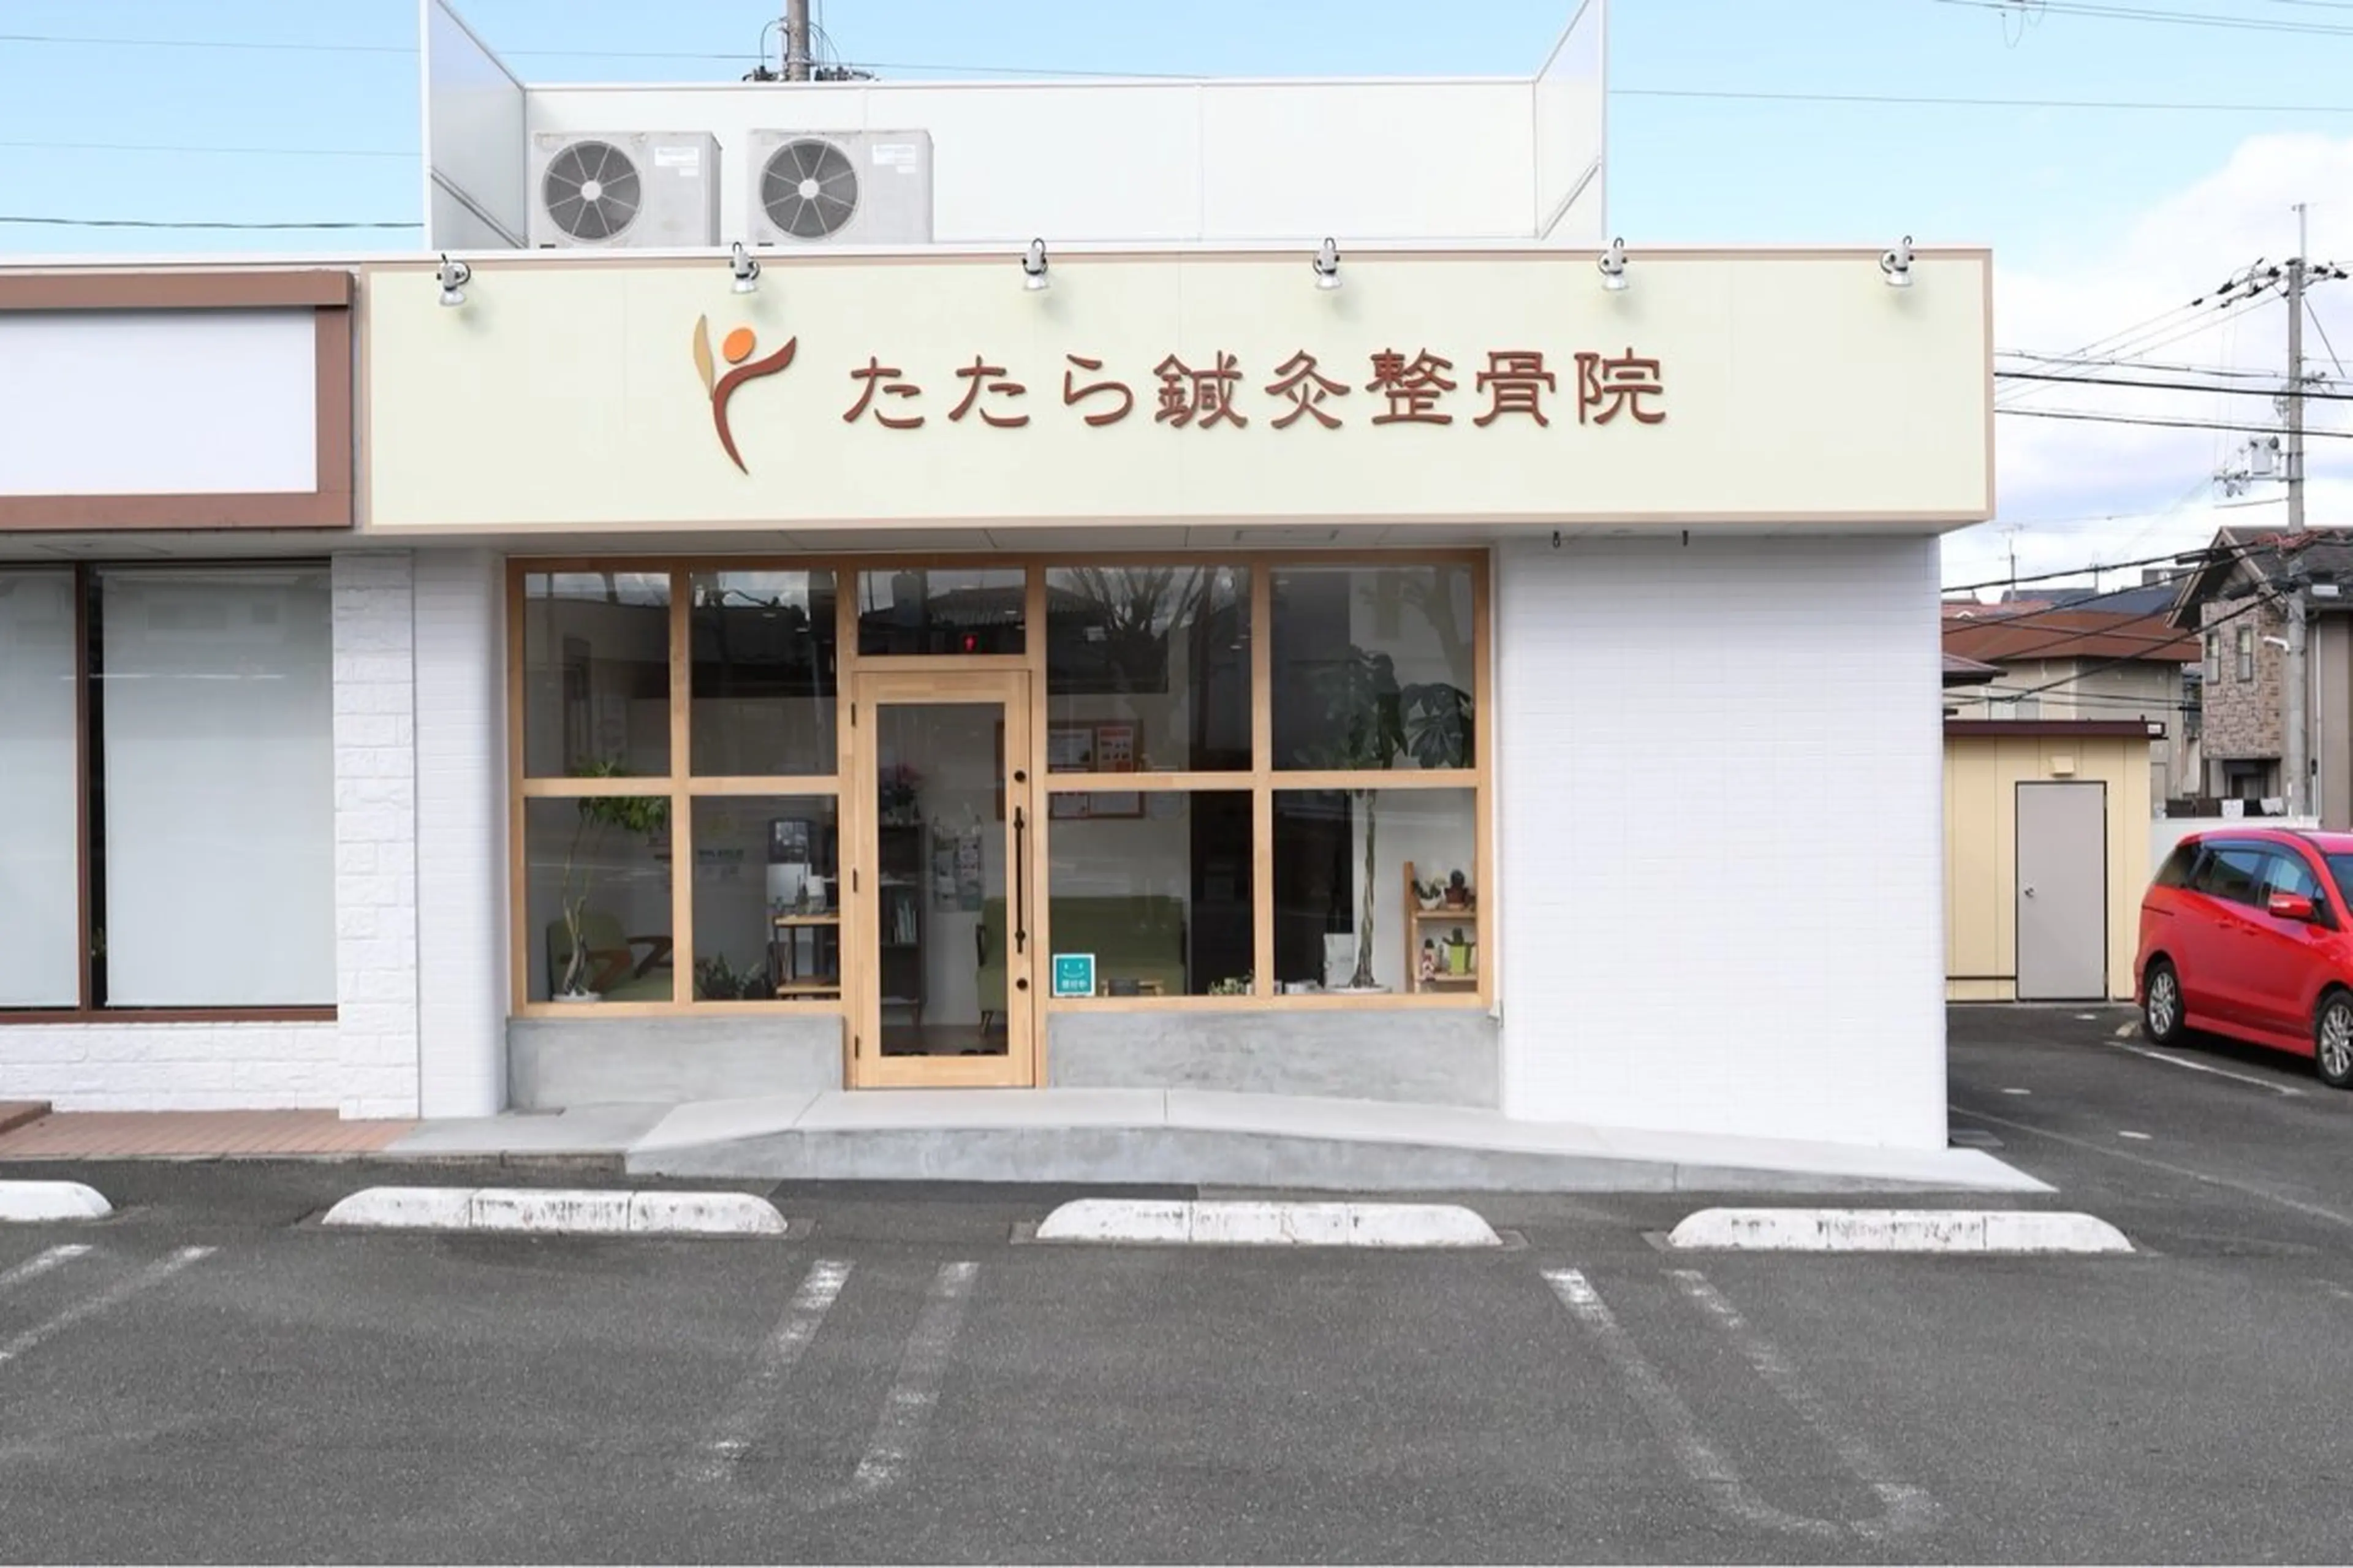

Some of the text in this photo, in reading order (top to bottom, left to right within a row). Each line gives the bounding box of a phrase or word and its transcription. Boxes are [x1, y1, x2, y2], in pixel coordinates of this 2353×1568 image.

[842, 346, 1667, 431] たたら鍼灸整骨院
